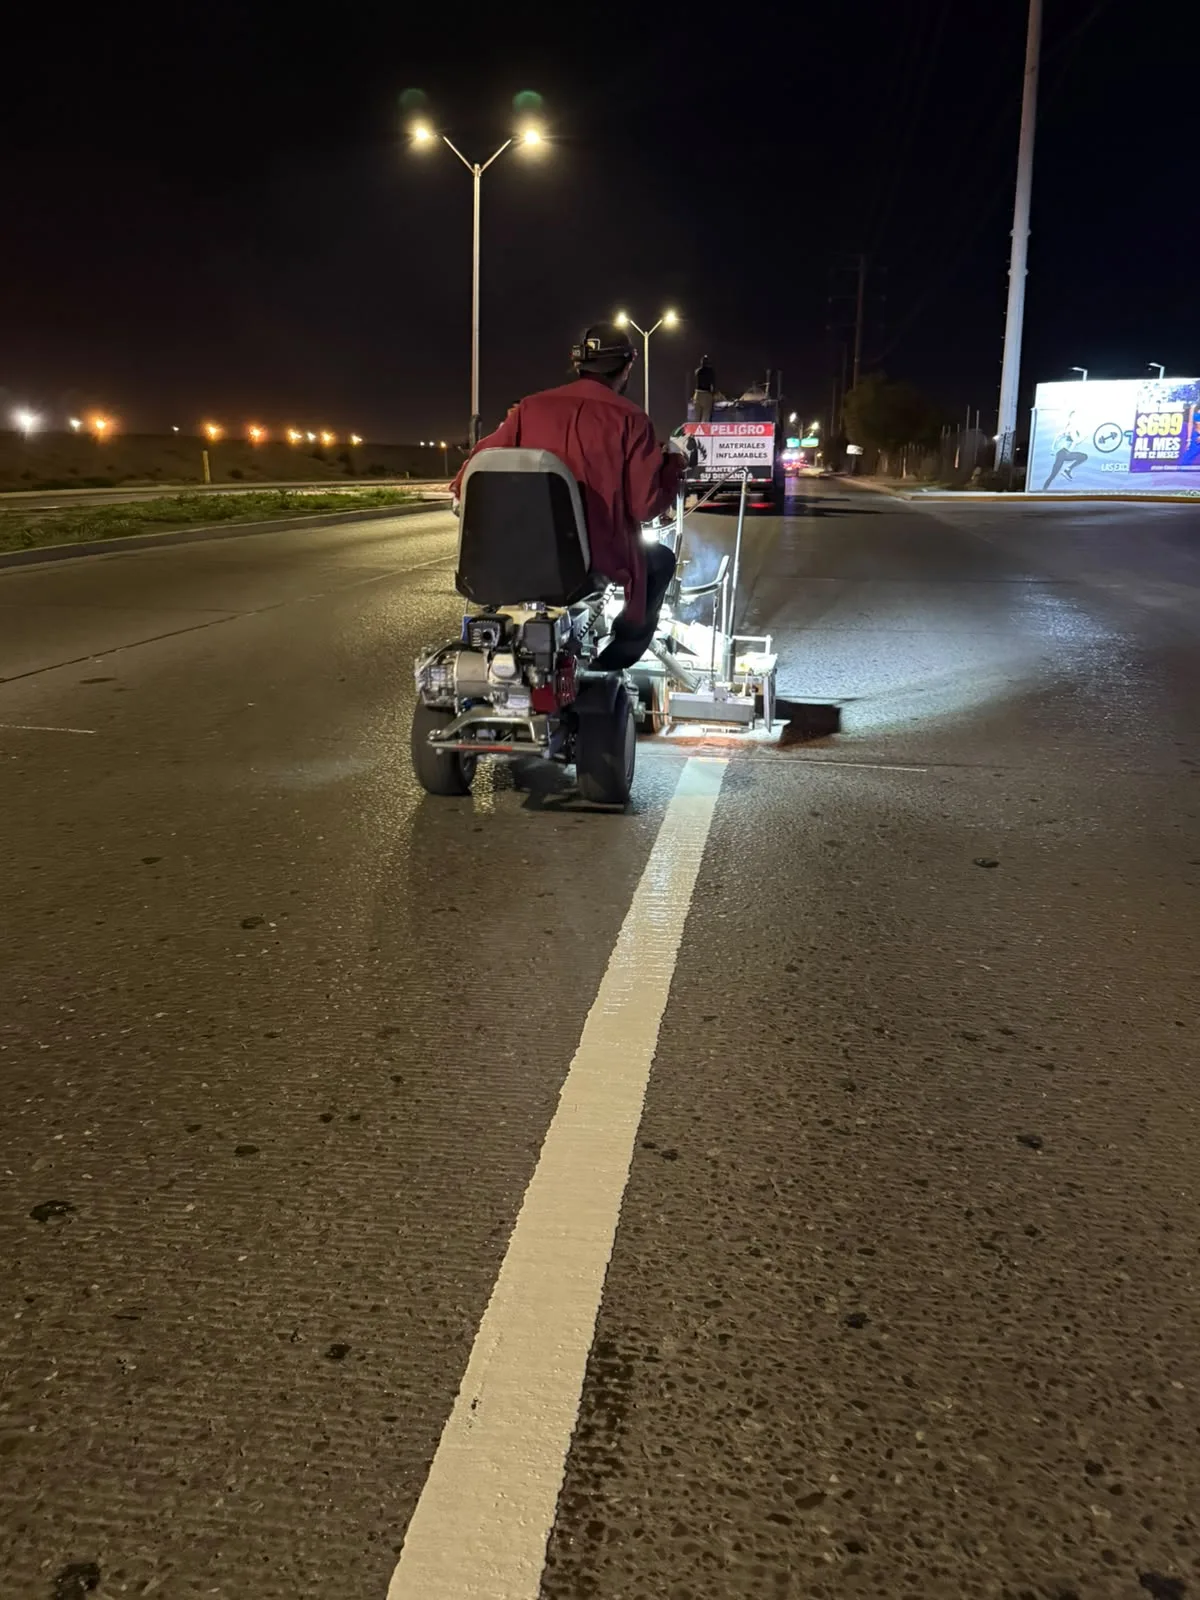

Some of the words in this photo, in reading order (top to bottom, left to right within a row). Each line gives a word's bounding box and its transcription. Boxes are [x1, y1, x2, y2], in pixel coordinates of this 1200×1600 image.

[711, 424, 765, 435] PELIGRO
[1136, 413, 1183, 436] $699
[1135, 437, 1150, 451] AL
[1152, 437, 1181, 451] MES
